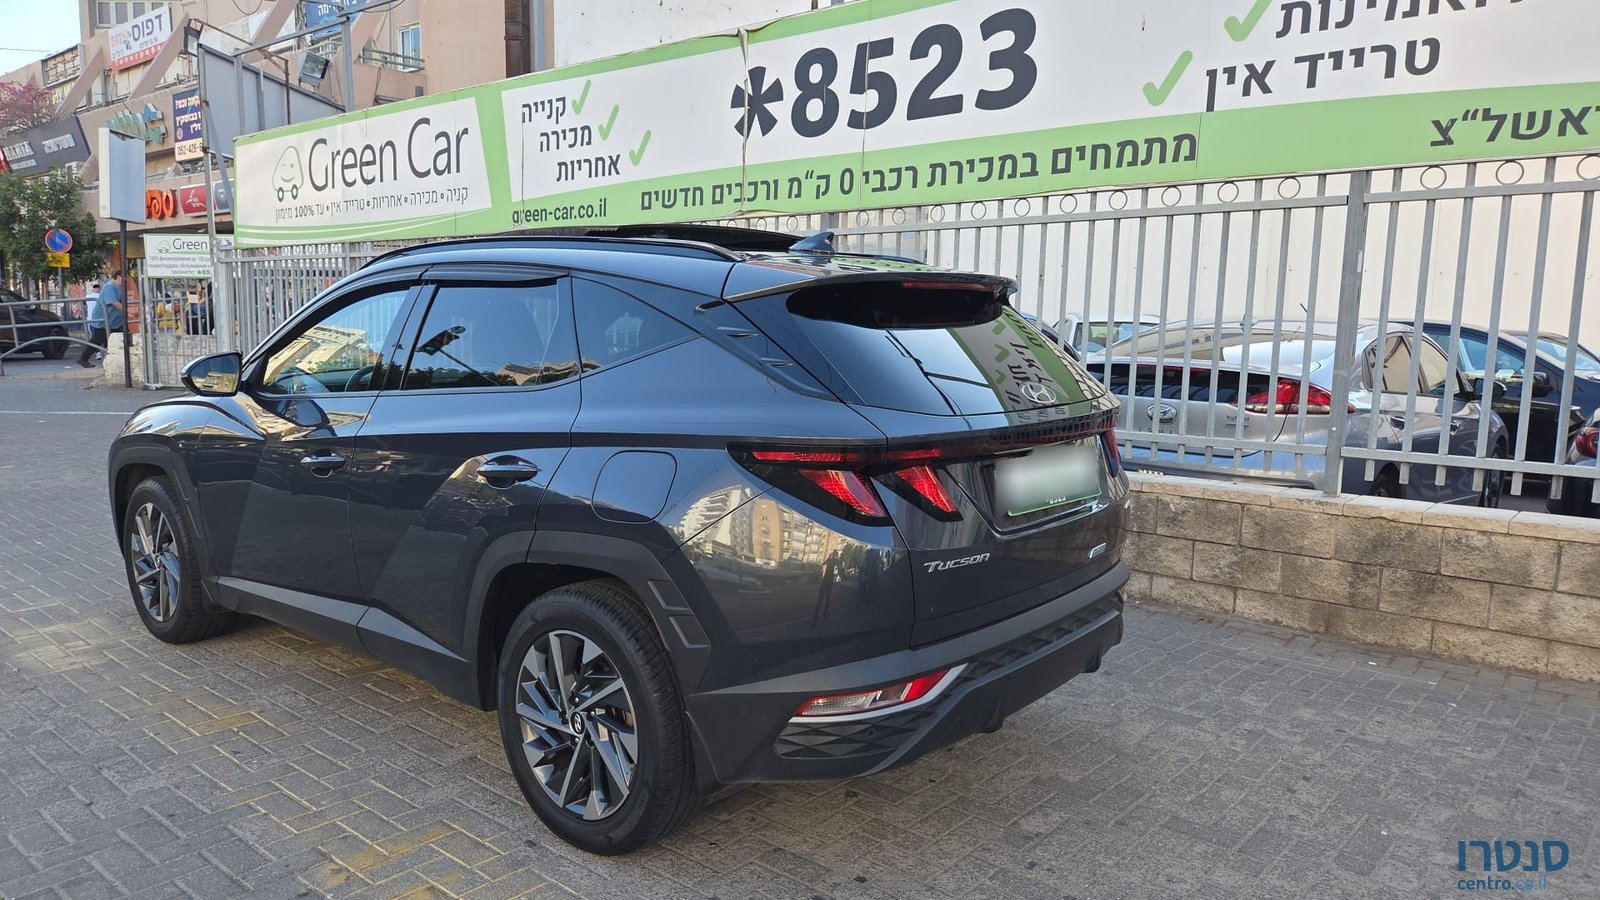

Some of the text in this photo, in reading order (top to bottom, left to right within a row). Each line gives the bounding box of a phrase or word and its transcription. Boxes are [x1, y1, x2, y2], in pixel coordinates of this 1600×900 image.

[131, 13, 163, 42] דפוס
[1206, 38, 1441, 112] טרייד אין
[522, 97, 567, 124] קנייה
[540, 125, 592, 152] מכירה
[308, 117, 469, 193] Green Car
[1051, 133, 1198, 175] מתמחים
[556, 154, 621, 183] אחריות
[863, 166, 918, 192] רכבי
[927, 152, 1038, 187] במכירת
[712, 180, 779, 205] ורכבים
[840, 168, 854, 196] 0
[343, 199, 365, 212] טרייד
[372, 195, 402, 210] אחריות
[411, 191, 438, 205] מכירה
[447, 187, 468, 205] קניה
[641, 186, 704, 210] חדשים
[294, 205, 315, 218] 100%
[315, 204, 325, 216] עד
[330, 202, 342, 217] אין
[512, 199, 607, 225] green-car.co.il
[173, 238, 208, 250] Green
